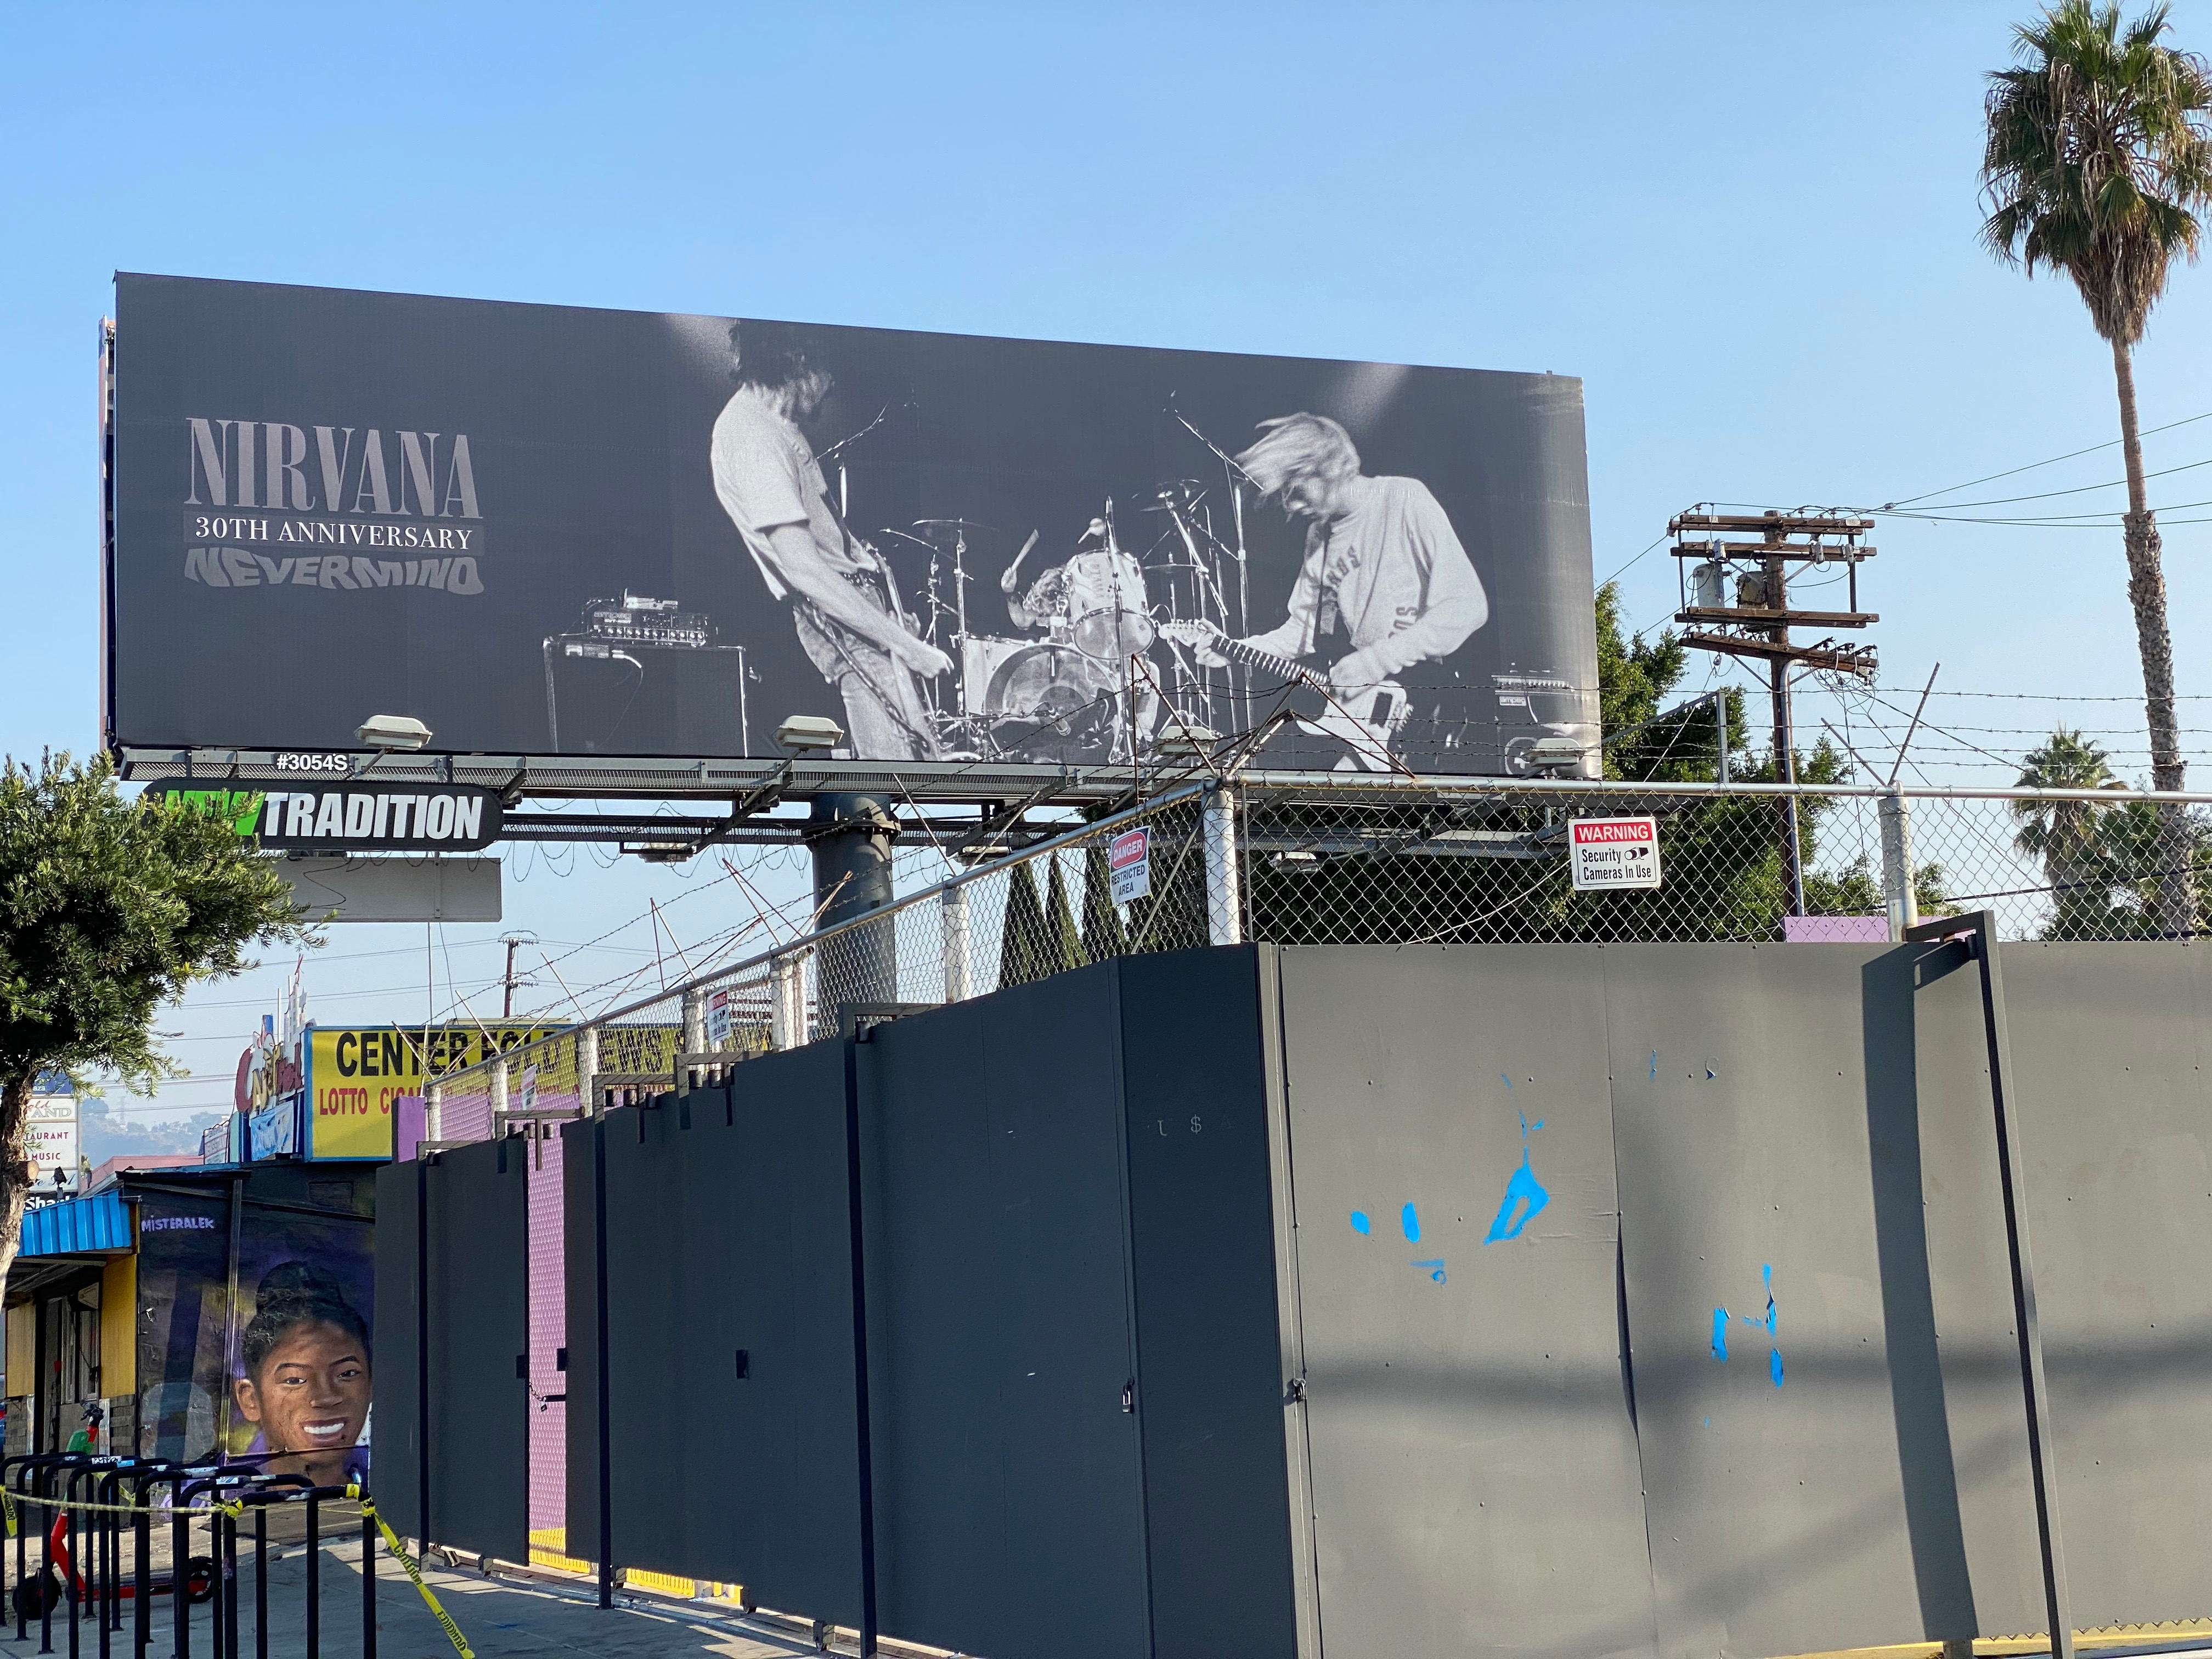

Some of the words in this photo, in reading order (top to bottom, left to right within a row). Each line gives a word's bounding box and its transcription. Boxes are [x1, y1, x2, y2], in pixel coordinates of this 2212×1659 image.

[184, 417, 483, 519] NIRVANA
[195, 517, 268, 541] 30TH
[277, 521, 473, 550] ANNIVERSARY
[184, 547, 484, 595] NEVERMIND
[276, 754, 348, 771] #3054S
[264, 792, 483, 840] TRADITION
[1578, 825, 1649, 842] WARNING
[1113, 838, 1143, 862] DANGER
[1582, 848, 1621, 864] Security
[1111, 864, 1146, 885] RESTRICTED
[1583, 866, 1623, 881] Cameras
[1626, 865, 1633, 878] In
[1636, 864, 1651, 878] Use
[1118, 882, 1134, 896] AREA
[336, 1032, 468, 1077] CENTER
[319, 1087, 368, 1116] LOTTO
